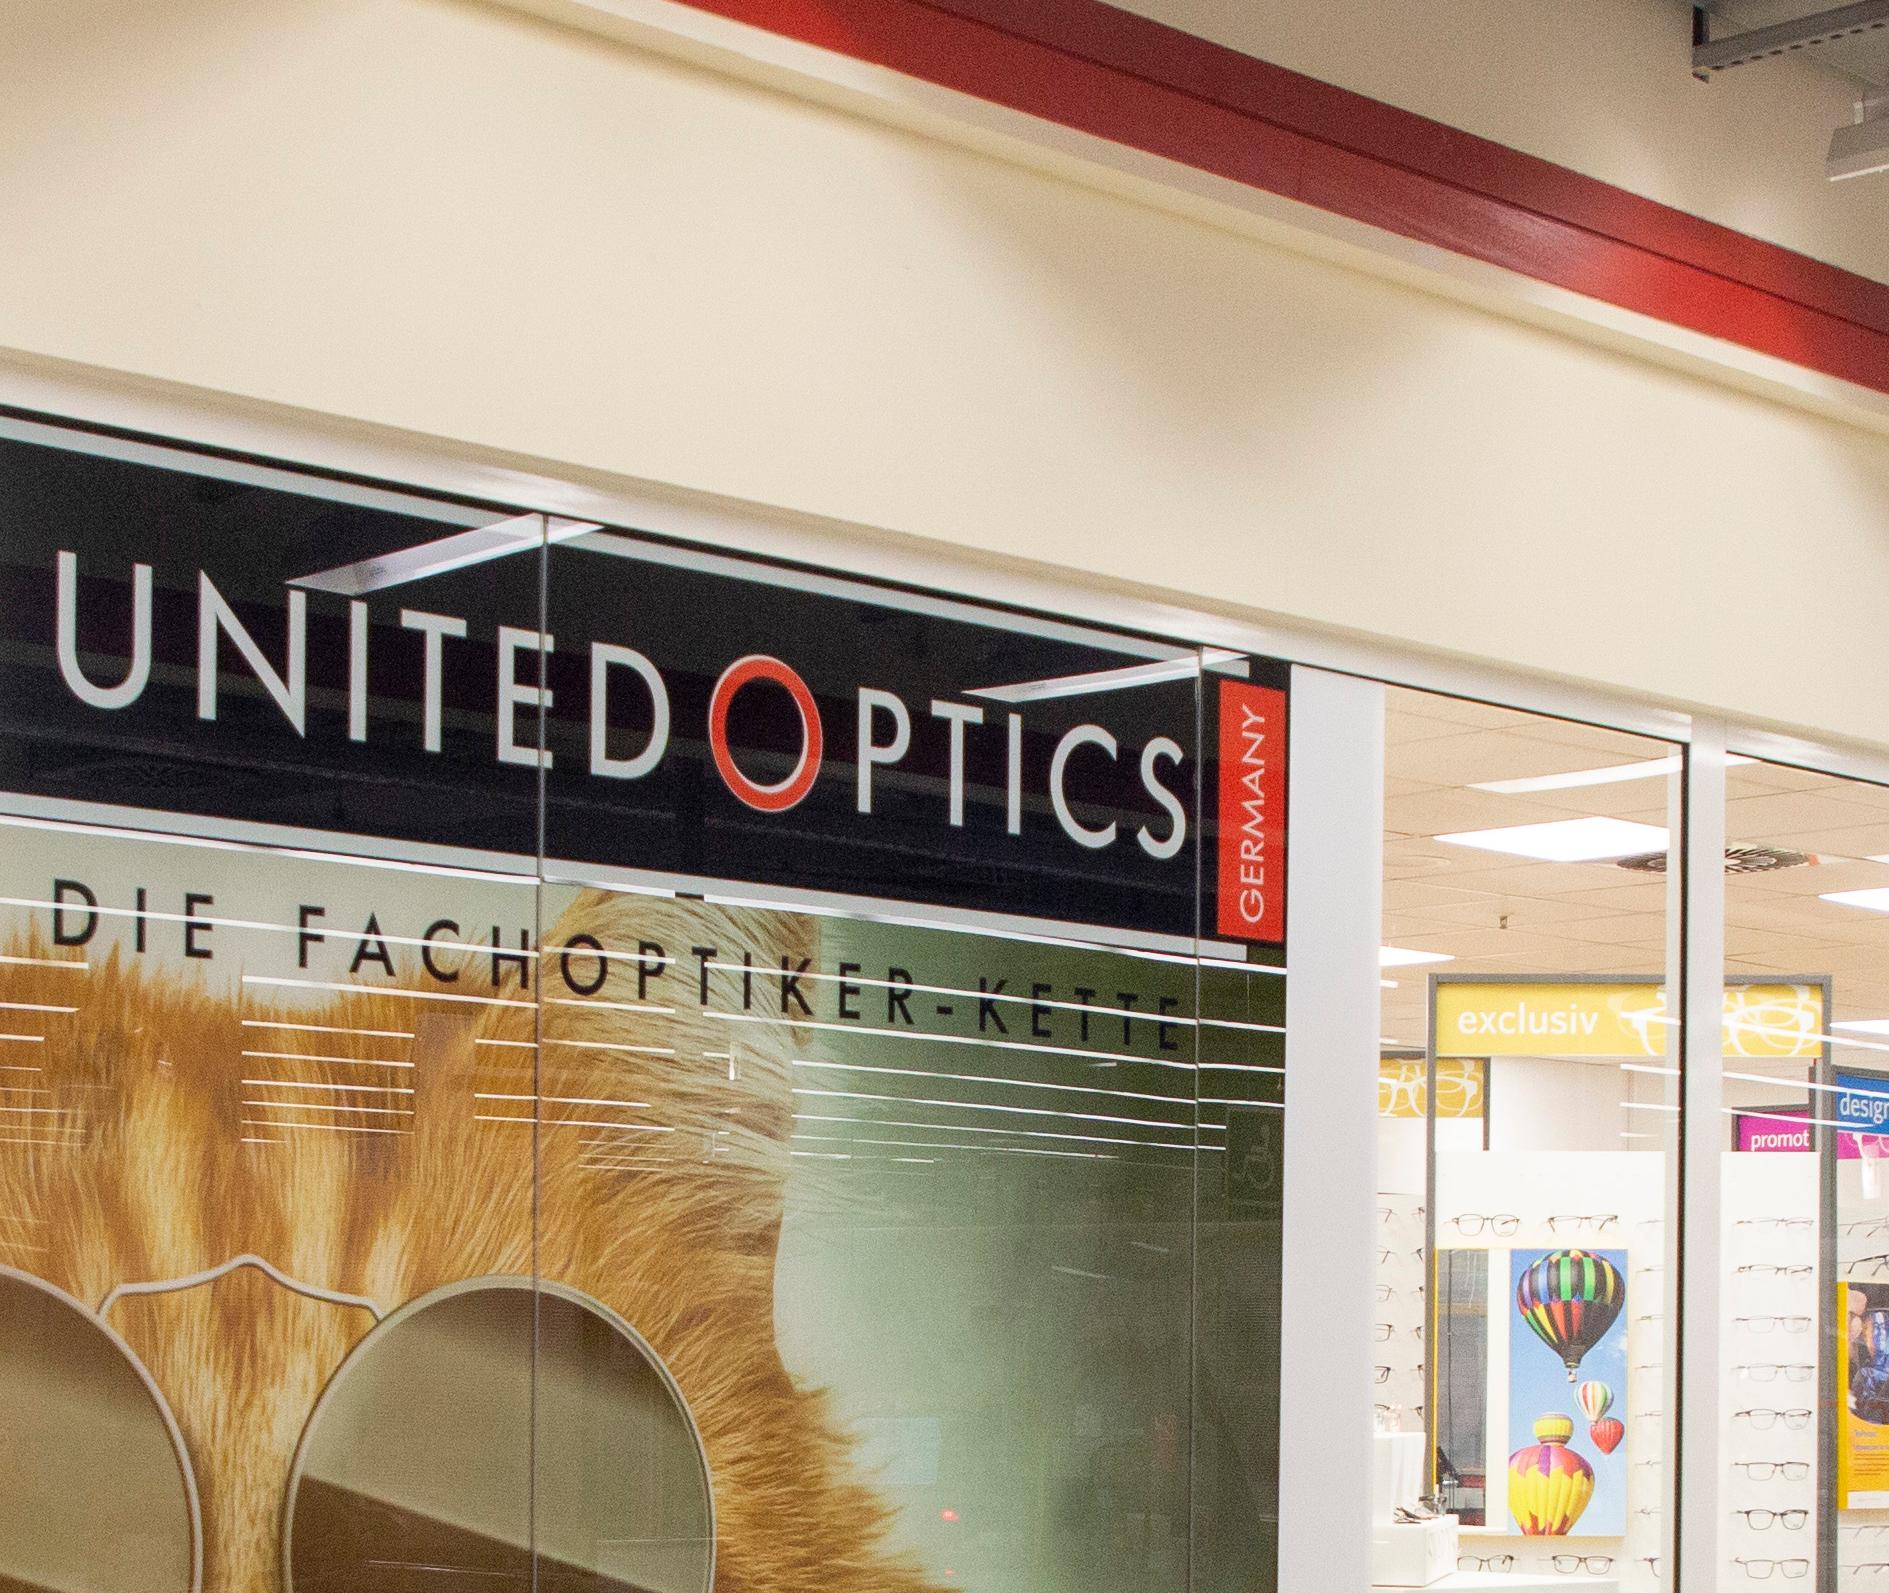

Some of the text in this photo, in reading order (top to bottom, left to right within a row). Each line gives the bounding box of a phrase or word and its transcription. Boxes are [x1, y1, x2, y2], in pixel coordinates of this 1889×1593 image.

[56, 550, 1186, 861] UNITED OPTICS
[1239, 703, 1269, 924] GERMANY
[51, 878, 1181, 1053] DIE FACHOPTIKER-KETTE
[1458, 1002, 1598, 1035] exclusiv
